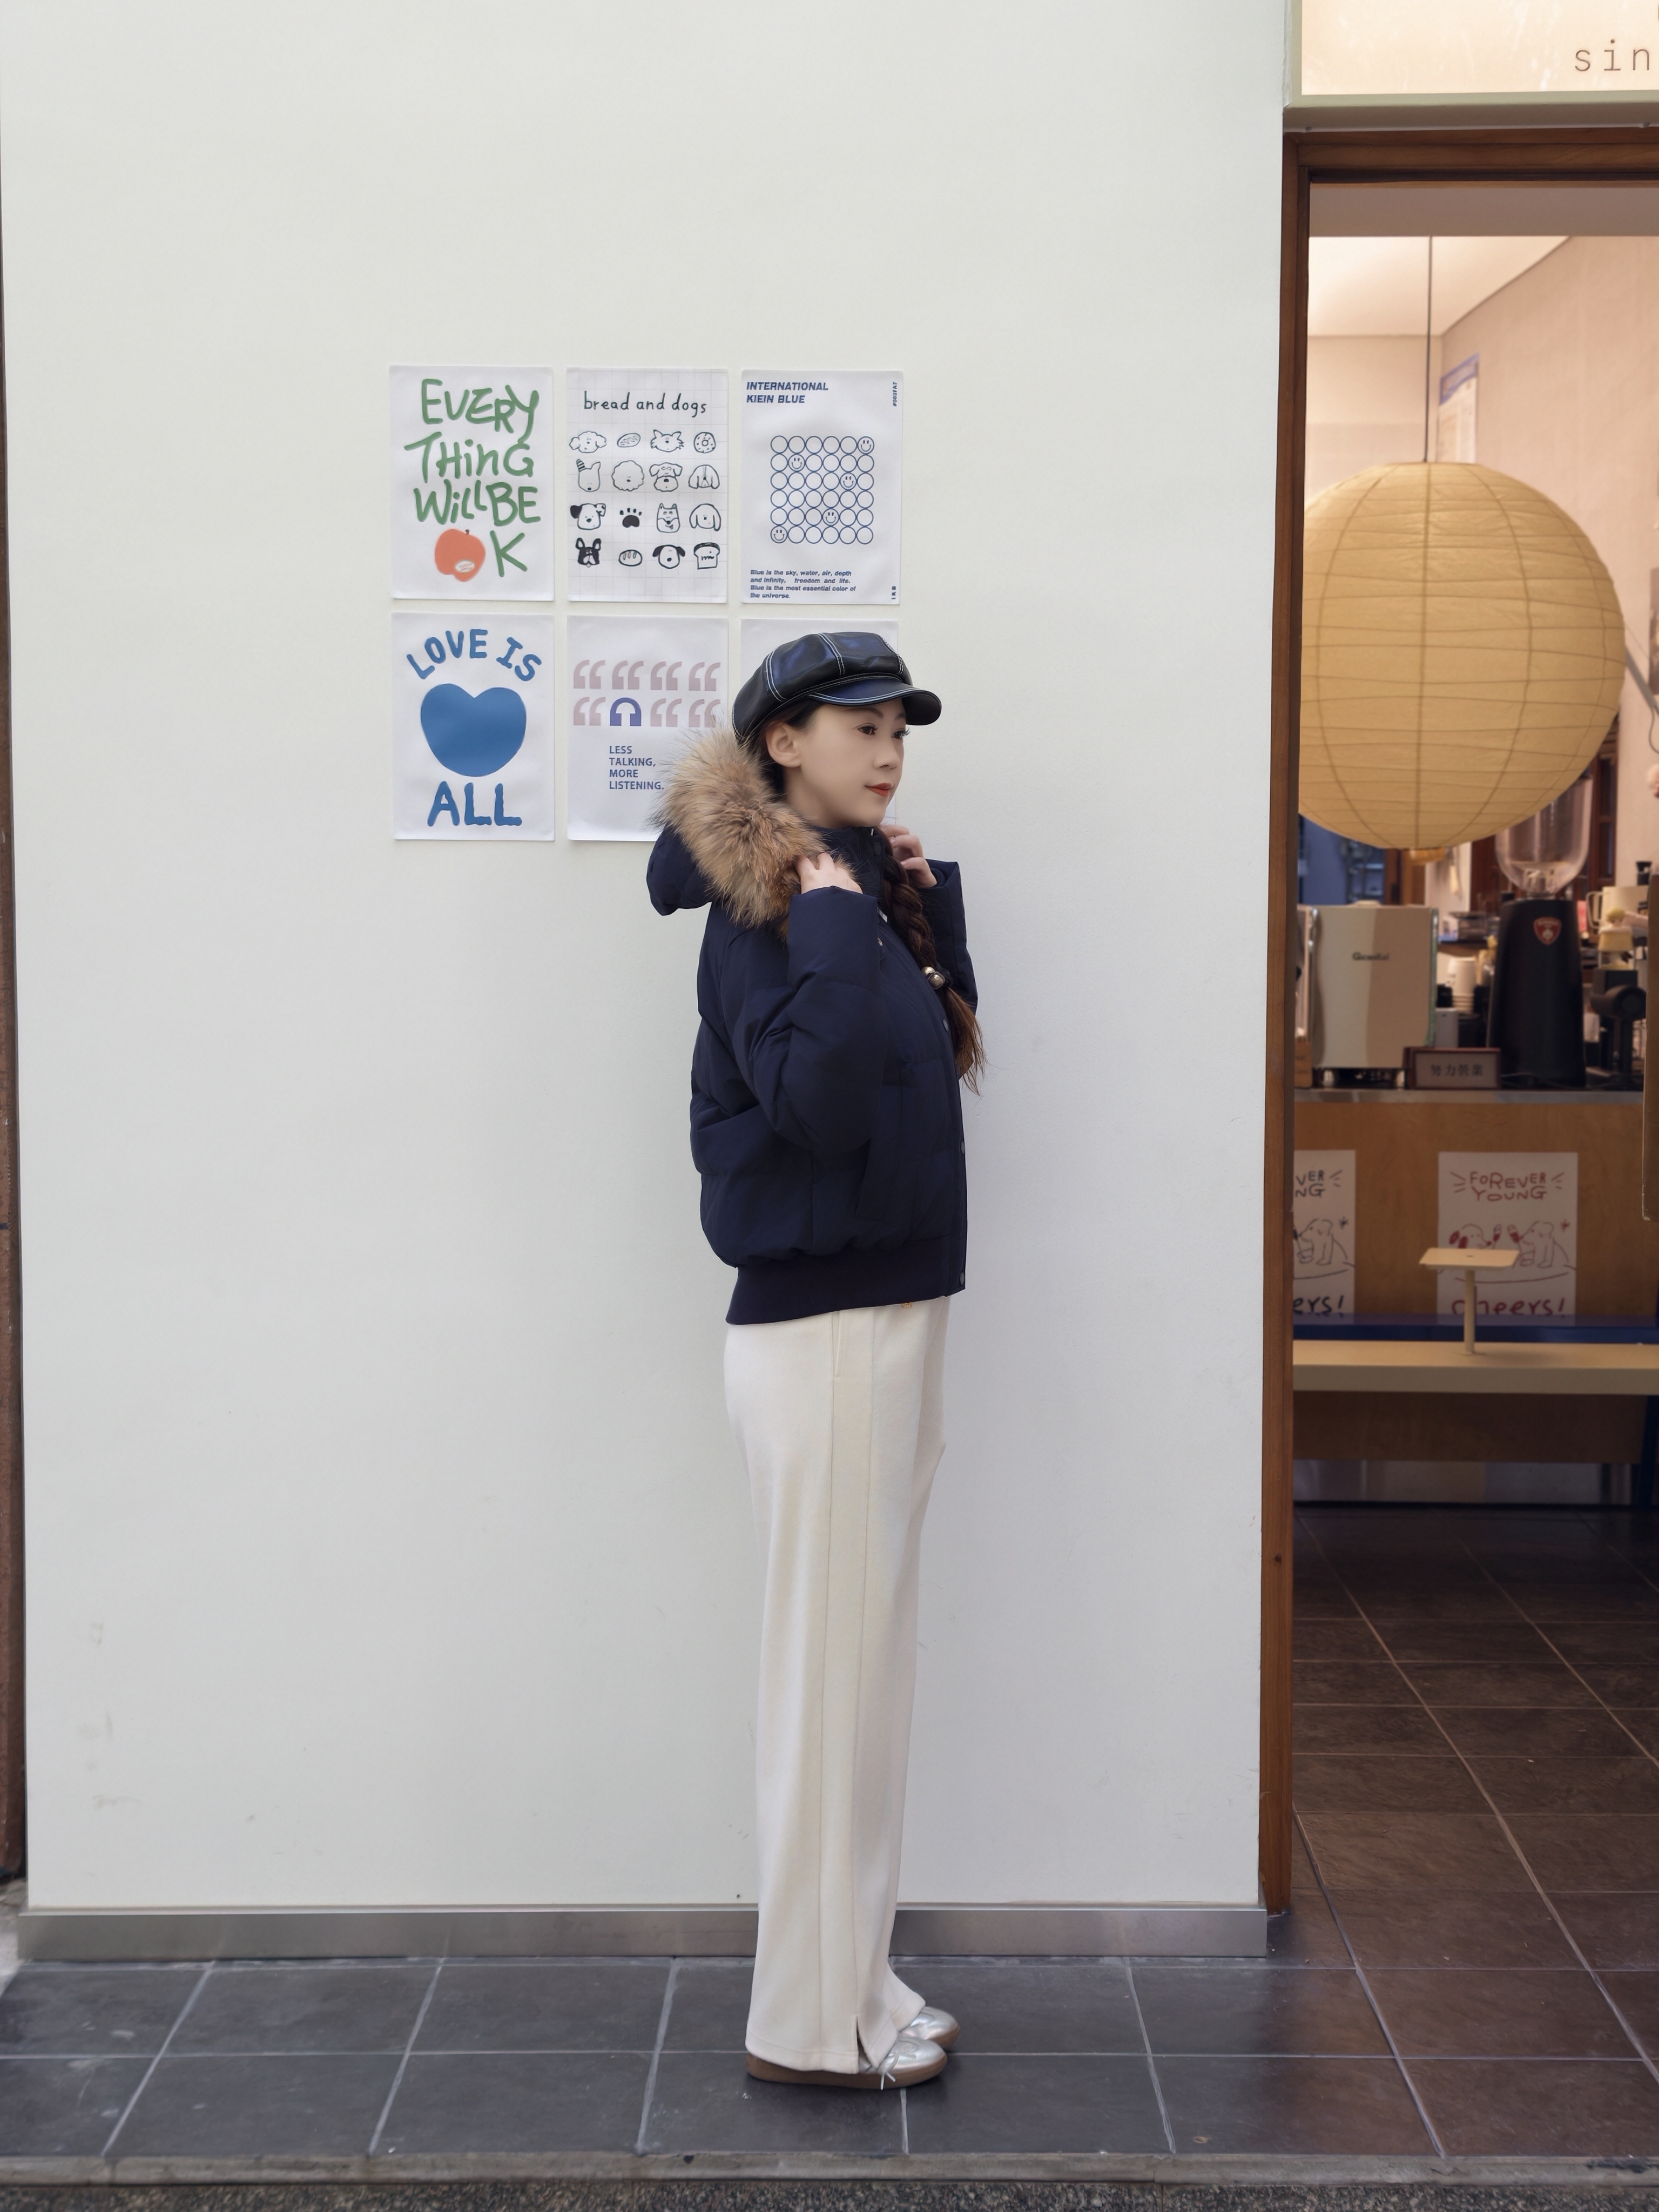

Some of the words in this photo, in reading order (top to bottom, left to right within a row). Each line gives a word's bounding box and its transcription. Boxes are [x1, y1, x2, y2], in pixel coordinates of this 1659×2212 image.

[746, 381, 828, 391] INTERNATIONAL
[584, 390, 630, 410] bread
[636, 392, 666, 410] and
[671, 392, 707, 418] dogs
[778, 395, 806, 403] BLUE
[421, 378, 539, 444] EVERY
[406, 629, 488, 679] LOVE
[496, 636, 542, 682] IS
[609, 745, 632, 754] LESS
[609, 757, 657, 767] TALKING,
[609, 770, 638, 778] MORE
[609, 781, 665, 790] LISTENING.
[427, 781, 522, 827] ALL
[1469, 1171, 1546, 1190] FOREVER
[1471, 1185, 1548, 1202] YOUNG
